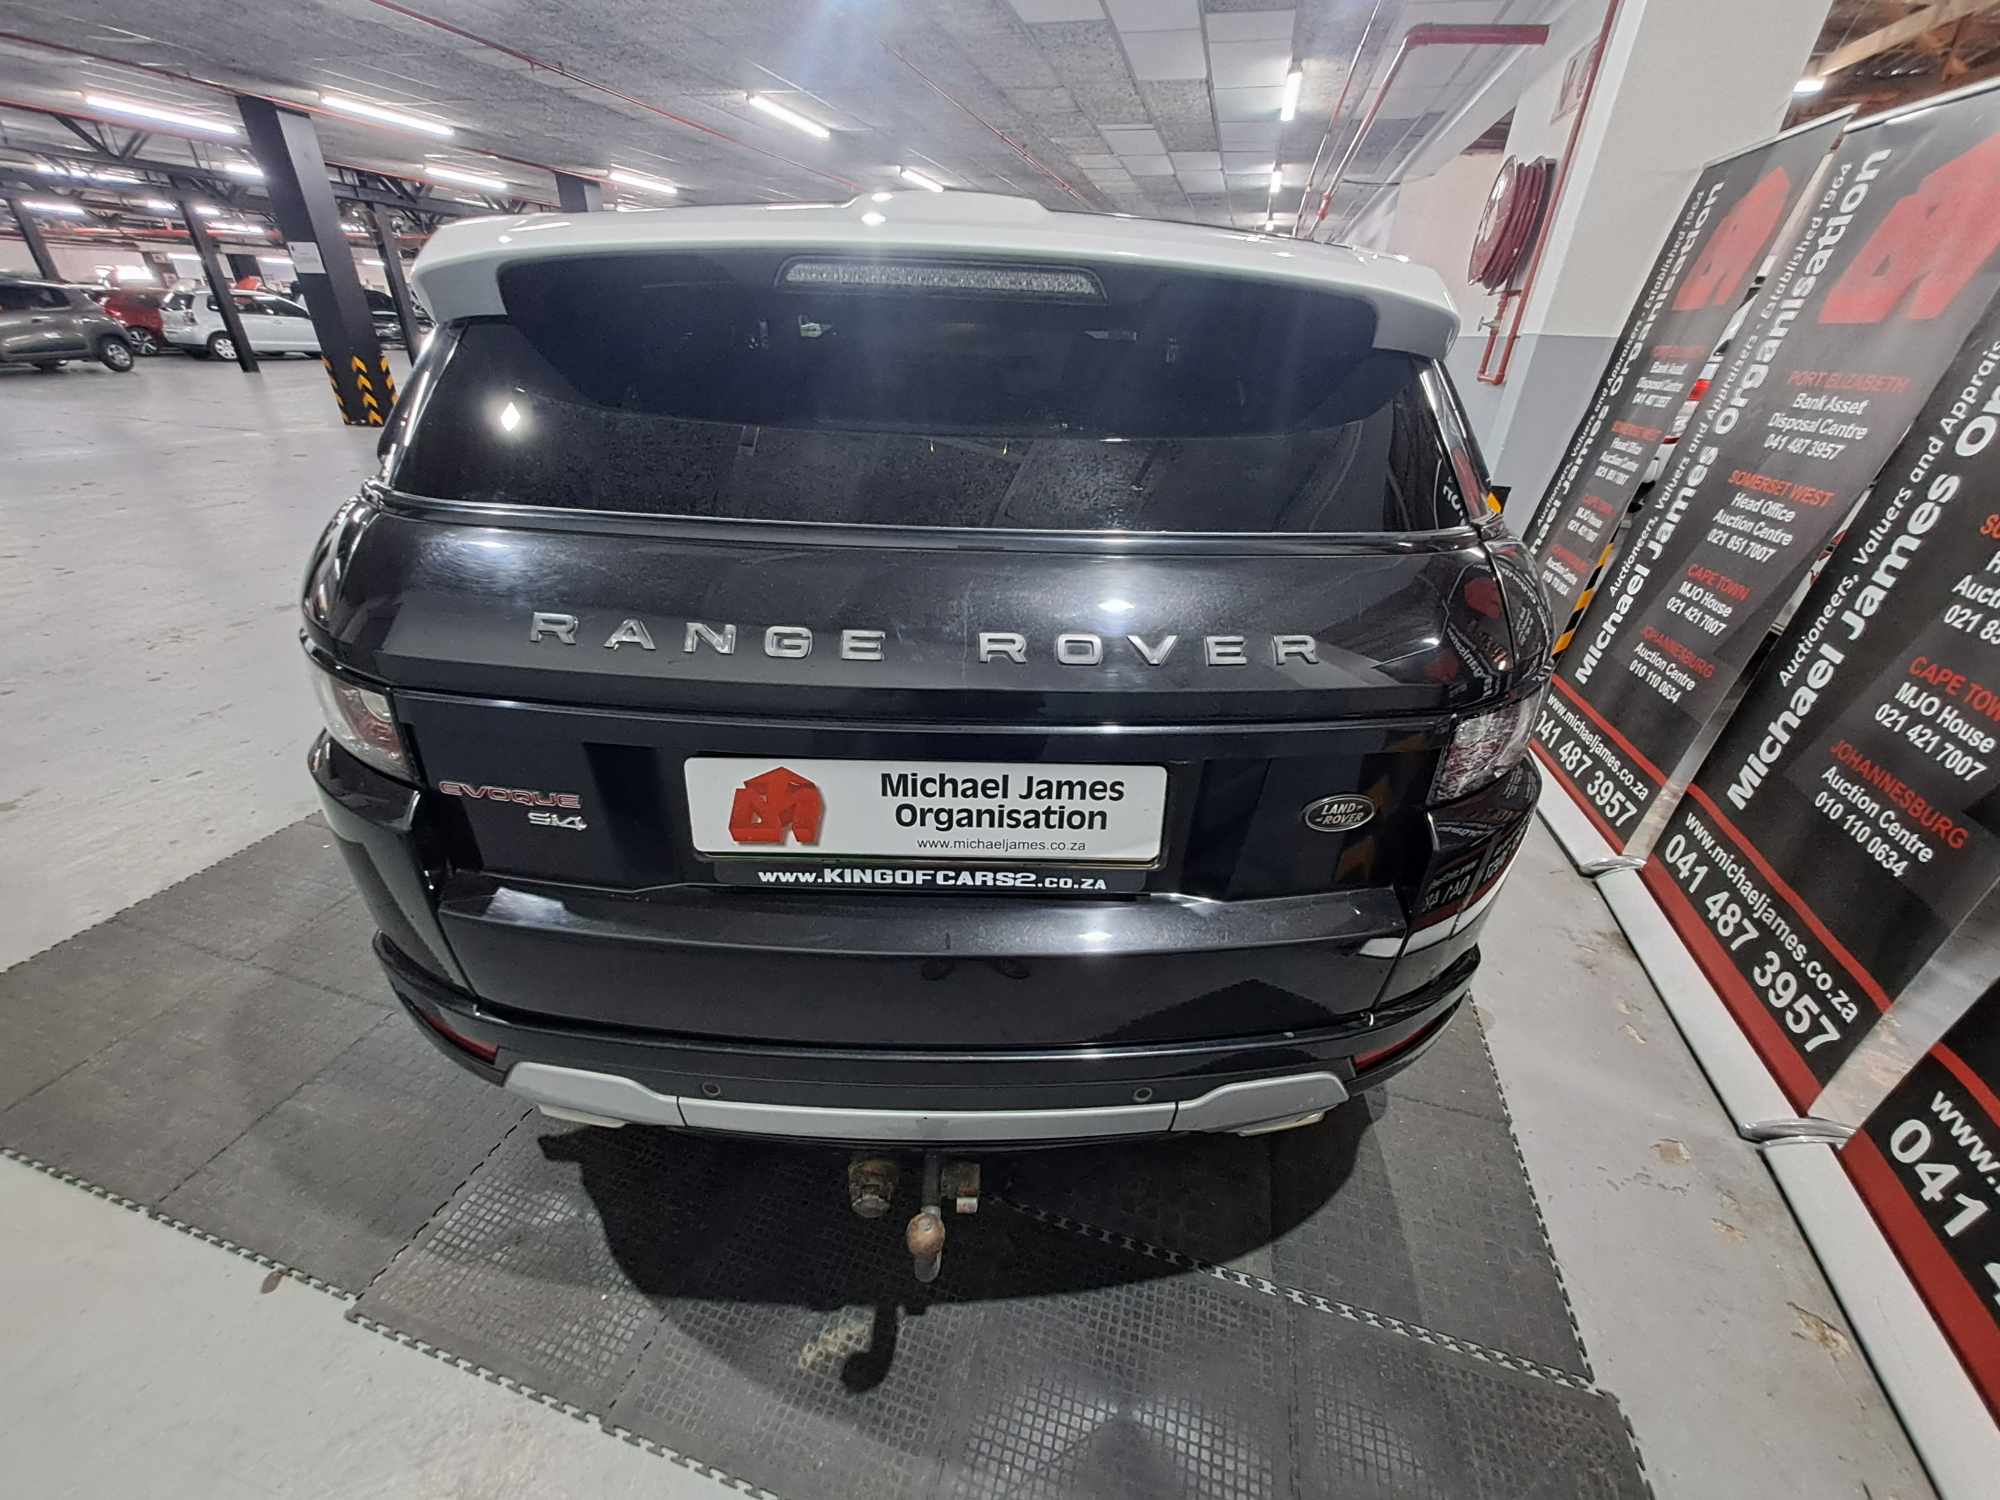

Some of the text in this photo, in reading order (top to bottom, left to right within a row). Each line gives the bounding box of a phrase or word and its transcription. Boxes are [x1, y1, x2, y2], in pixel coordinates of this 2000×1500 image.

[1609, 516, 1659, 597] Auctioneers,
[1655, 457, 1691, 509] Valuers
[1688, 422, 1709, 453] and
[1706, 335, 1758, 420] Appraisers
[1760, 217, 1823, 319] Established
[1819, 163, 1853, 210] 1964
[1574, 563, 1650, 685] Michael
[1648, 446, 1719, 560] James
[1714, 148, 1892, 434] Organisation
[1768, 412, 1868, 440] Disposal Centre
[1793, 393, 1869, 415] Bank Asset
[1764, 433, 1787, 450] 041
[1807, 440, 1846, 460] 3957
[1728, 469, 1835, 507] SOMERSET WEST
[1730, 492, 1796, 522] Head Office
[1706, 528, 1776, 563] 021 851 7007
[1713, 509, 1793, 546] Auction Centre
[1687, 564, 1751, 600] CAPE TOWN
[1778, 573, 1860, 687] Auctioneers,
[1852, 487, 1913, 565] Valuers
[1910, 436, 1945, 483] and
[1666, 597, 1727, 636] 021 421 7007
[1678, 581, 1733, 618] MJO House
[1943, 604, 1984, 633] 021
[529, 611, 1320, 666] RANGE ROVER
[1727, 643, 1845, 811] Michael
[1840, 473, 1961, 641] James
[1629, 659, 1683, 704] 010 110 0634
[1634, 642, 1696, 691] Auction Centre
[1909, 655, 1967, 696] CAPE
[1895, 681, 1996, 754] MJO House
[1547, 693, 1649, 801] www.michaeljames.co.za
[1875, 703, 1988, 782] 021 421 7007
[438, 780, 582, 809] EVOQUE
[880, 772, 1125, 801] Michael James
[1558, 740, 1593, 778] 487
[1587, 770, 1638, 827] 3957
[1830, 739, 1969, 849] JOHANNESBURG
[895, 803, 1108, 832] Organisation
[1814, 791, 1909, 878] 010 110 0634
[1821, 765, 1934, 863] Auction Centre
[917, 838, 1086, 853] www.michaeljames.co.za
[1685, 811, 1859, 1024] www.michaeljames.co.za
[1664, 833, 1841, 1053] 041 487 3957
[1931, 1090, 2000, 1196] www.
[1890, 1119, 1989, 1238] 041
